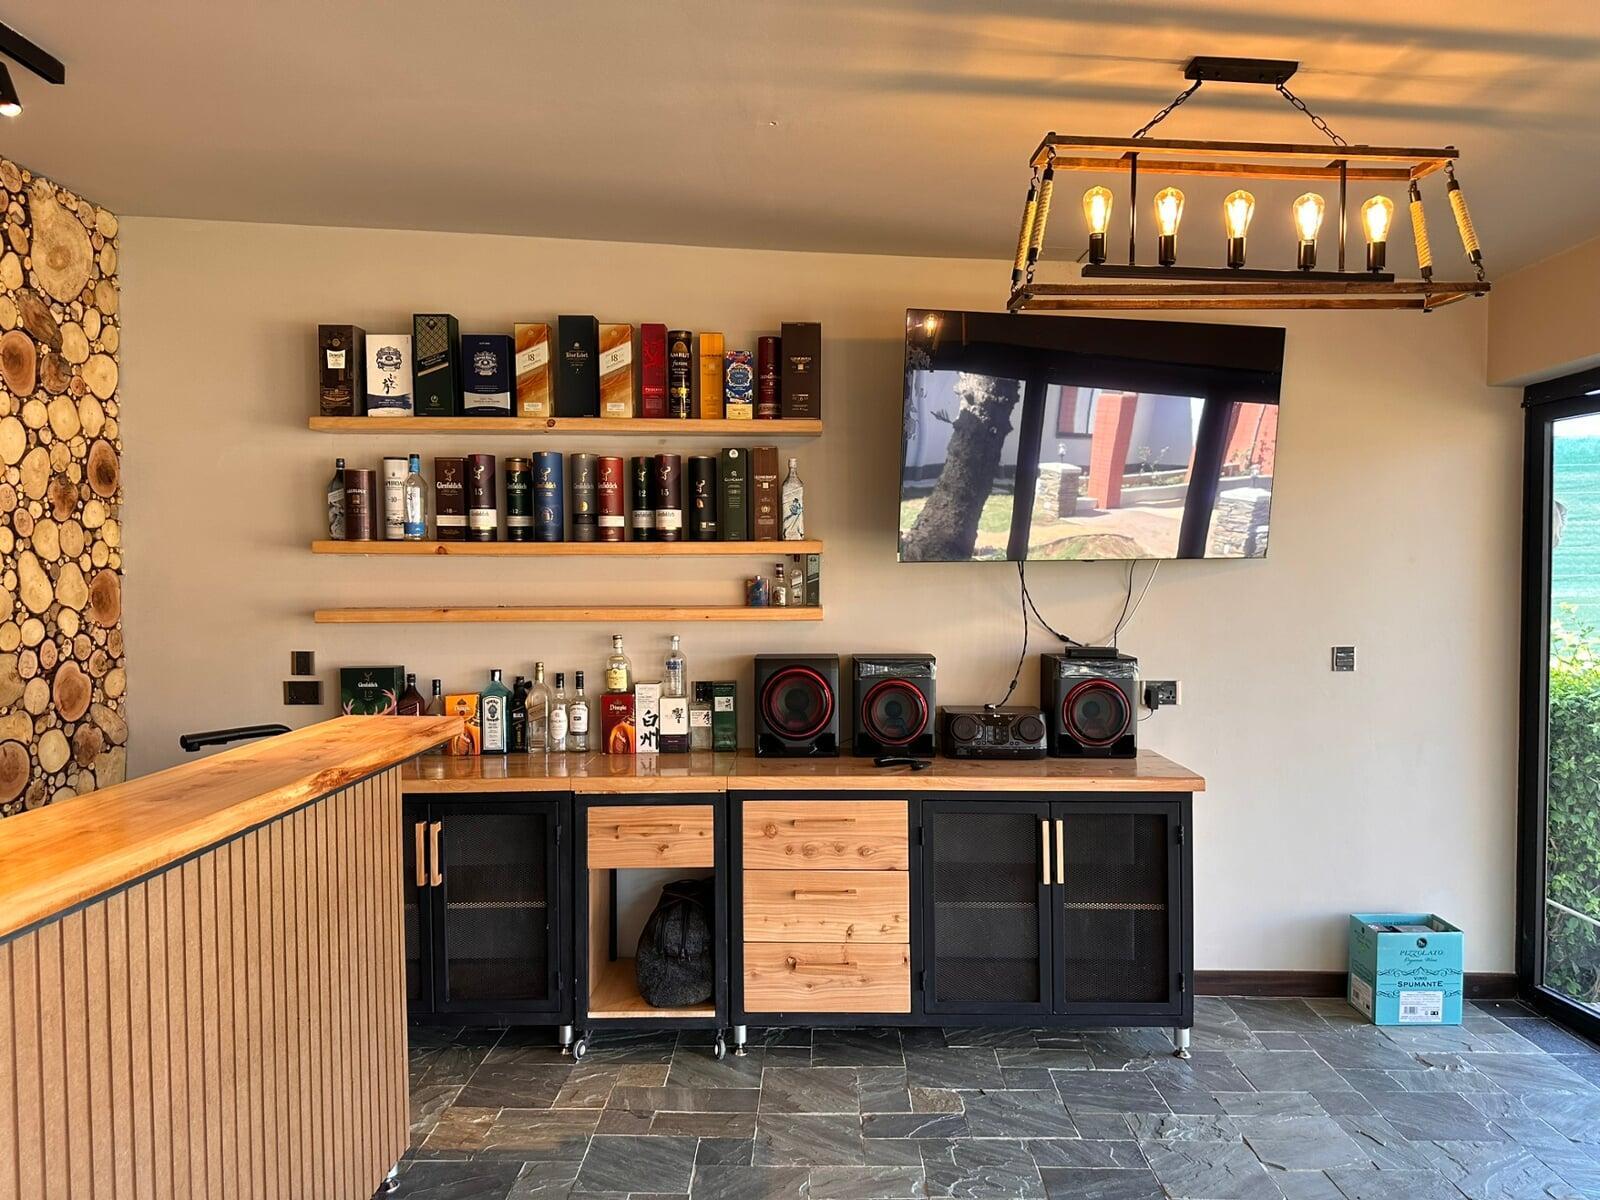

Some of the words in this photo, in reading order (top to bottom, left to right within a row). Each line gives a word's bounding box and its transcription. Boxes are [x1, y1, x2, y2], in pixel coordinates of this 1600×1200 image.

[436, 481, 463, 489] Glenfiddich
[475, 488, 484, 496] 15
[661, 488, 670, 496] 15
[640, 709, 660, 750] 白州
[1399, 949, 1444, 958] PIZZOLATO
[1397, 980, 1444, 988] SPUMANTE
